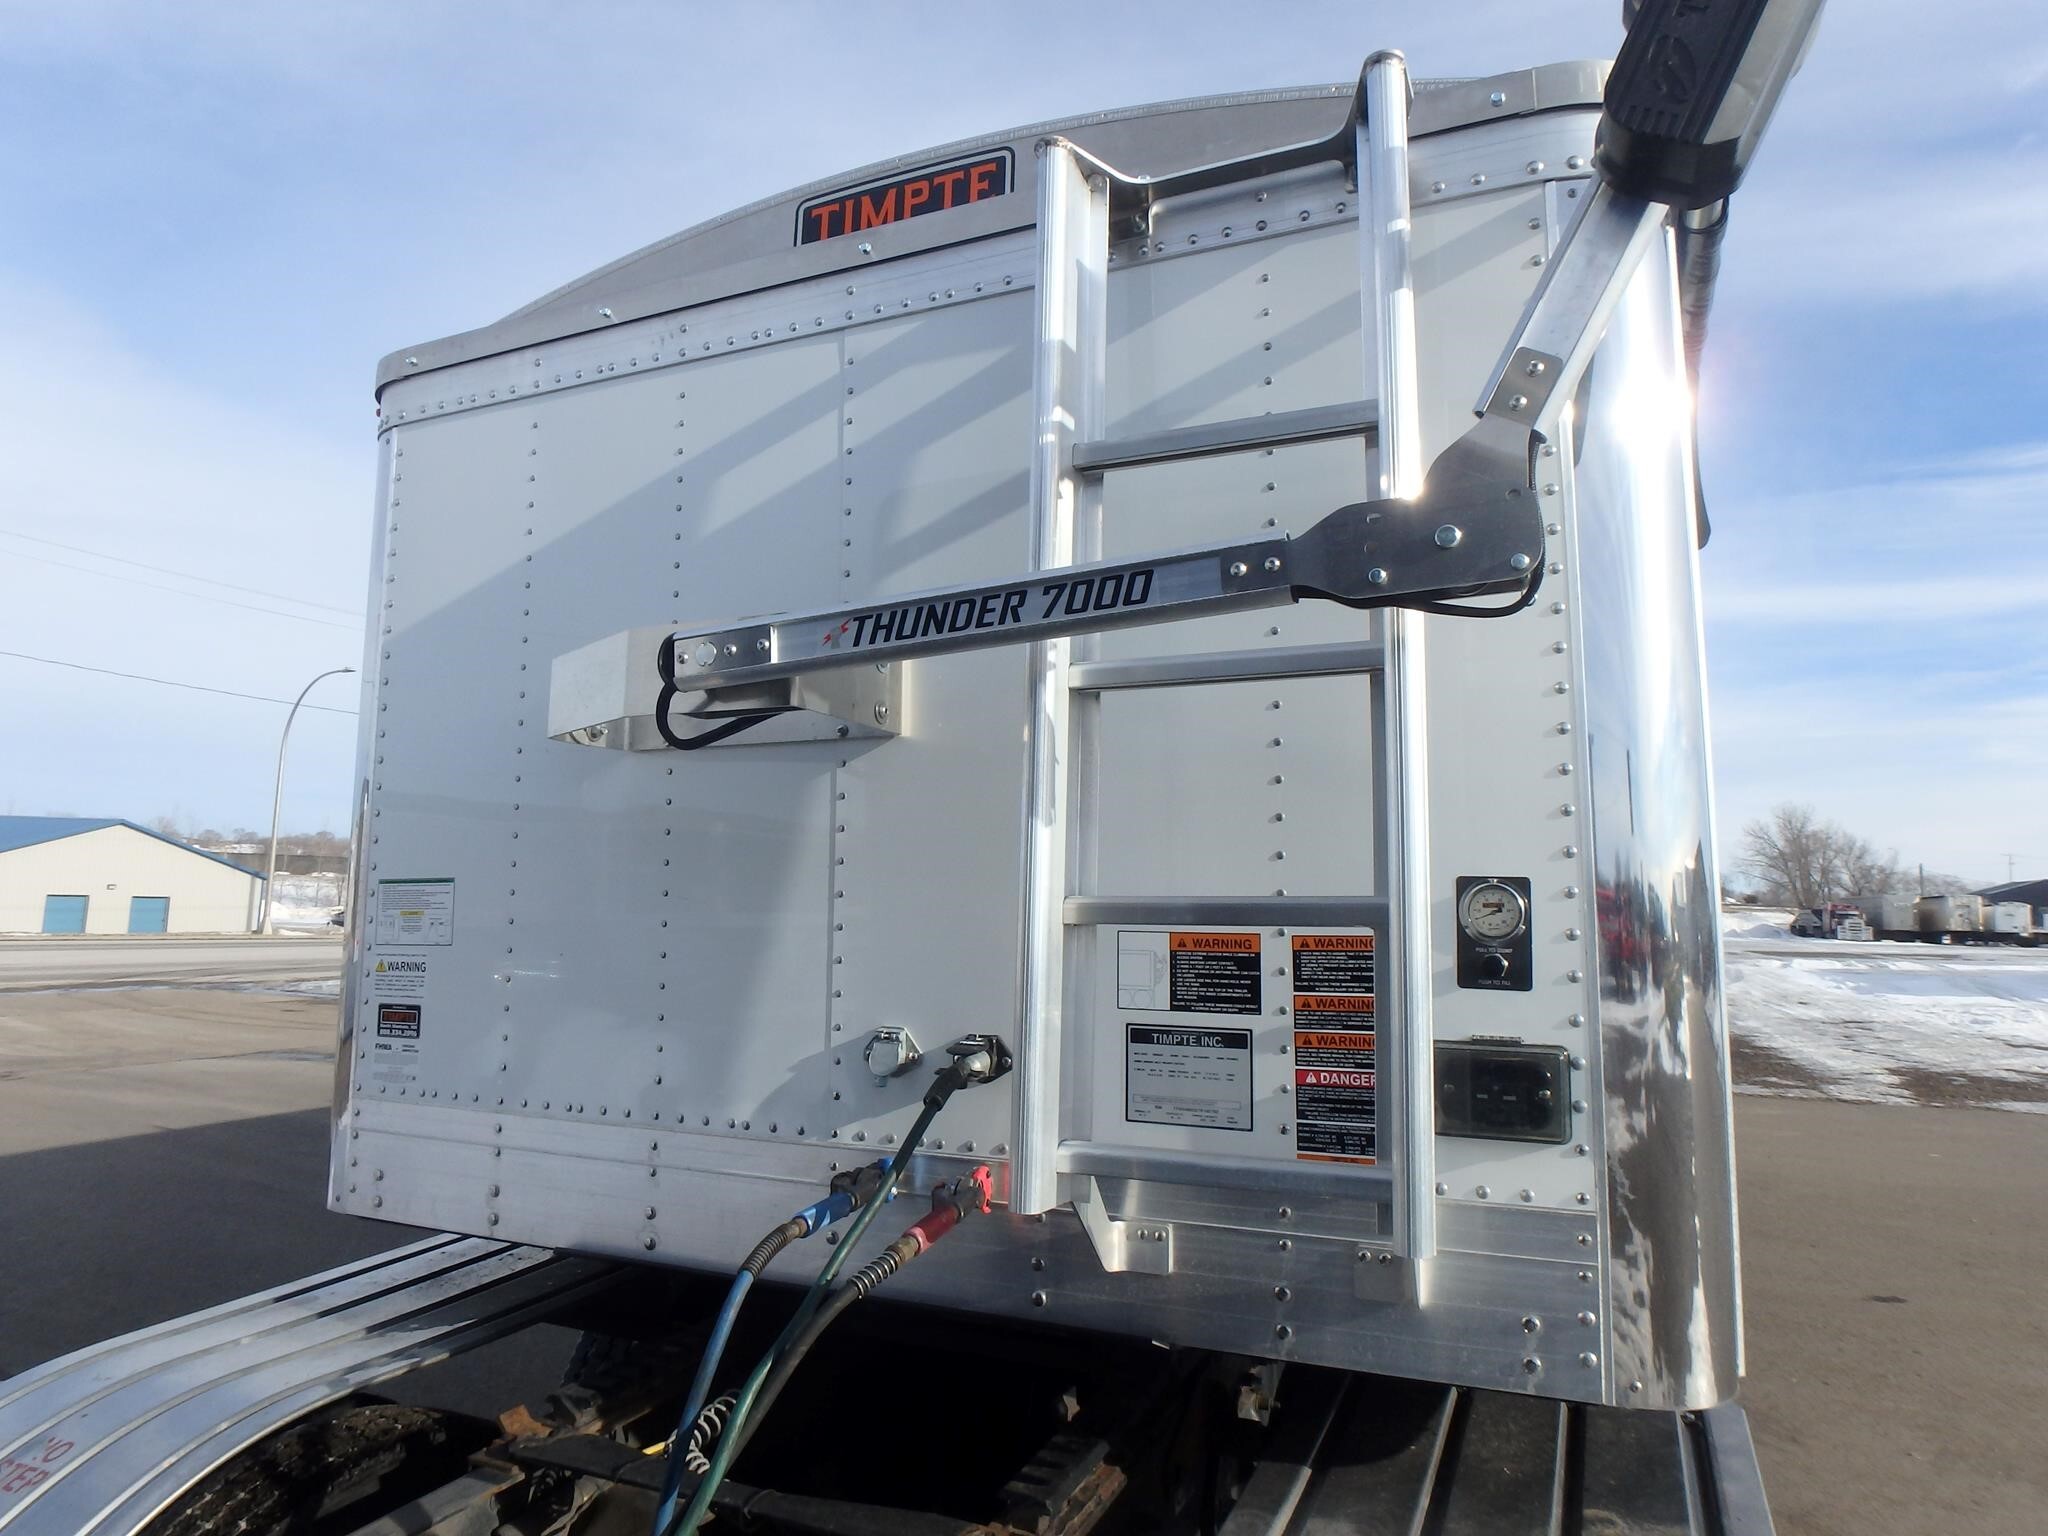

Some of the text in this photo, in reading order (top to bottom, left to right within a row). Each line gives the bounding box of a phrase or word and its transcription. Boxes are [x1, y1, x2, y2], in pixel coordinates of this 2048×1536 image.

[851, 568, 1155, 648] THUNDER 7000
[1192, 938, 1252, 950] WARNING
[387, 960, 426, 974] WARNING
[1315, 997, 1374, 1010] WARNIN
[1152, 1033, 1224, 1048] TIMPTE INC.
[1316, 1035, 1375, 1048] WARNIN
